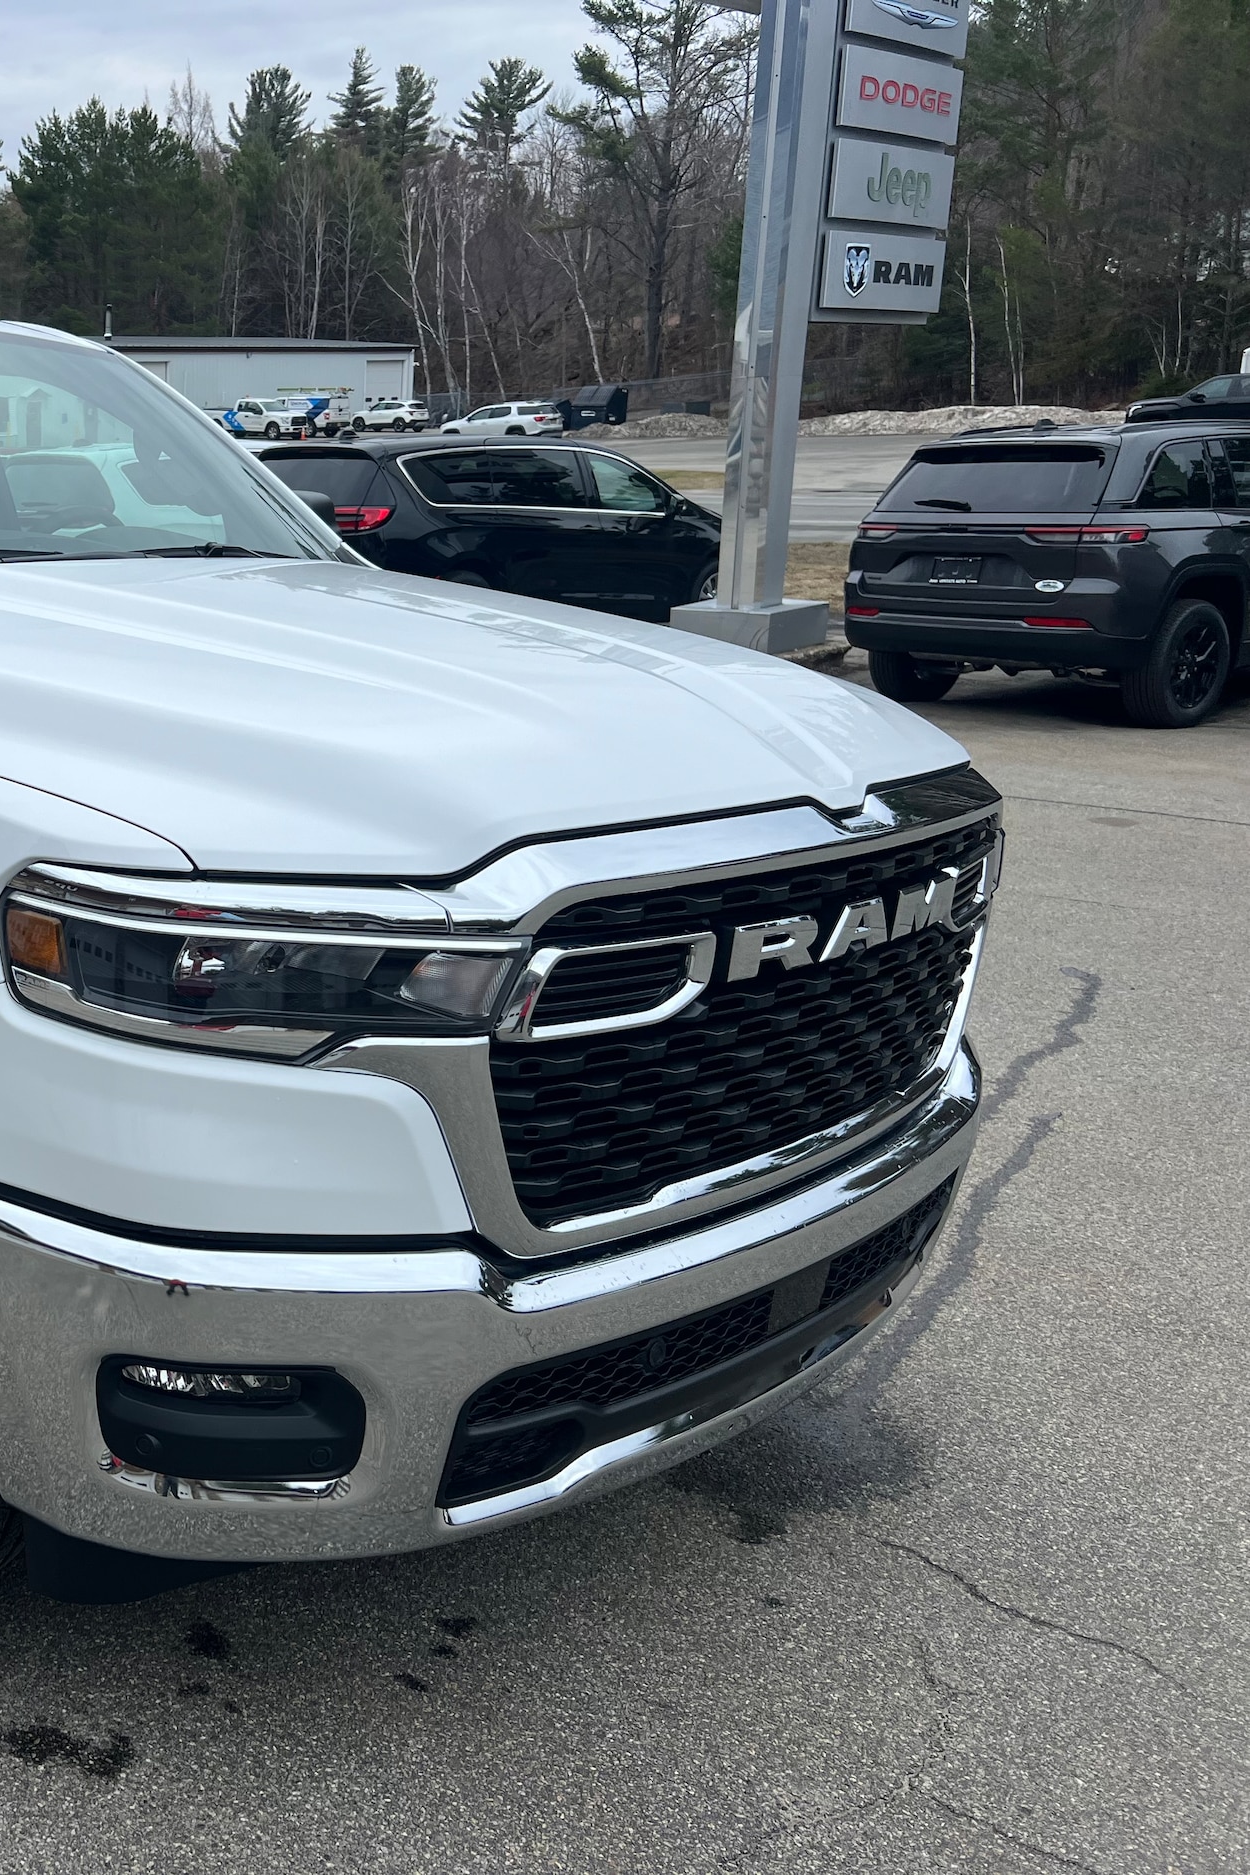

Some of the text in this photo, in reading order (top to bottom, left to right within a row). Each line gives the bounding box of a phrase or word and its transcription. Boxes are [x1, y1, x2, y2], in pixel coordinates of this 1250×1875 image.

[859, 75, 952, 115] DODGE
[867, 152, 931, 217] Jeep
[872, 260, 934, 287] RAM
[727, 866, 960, 982] RAM
